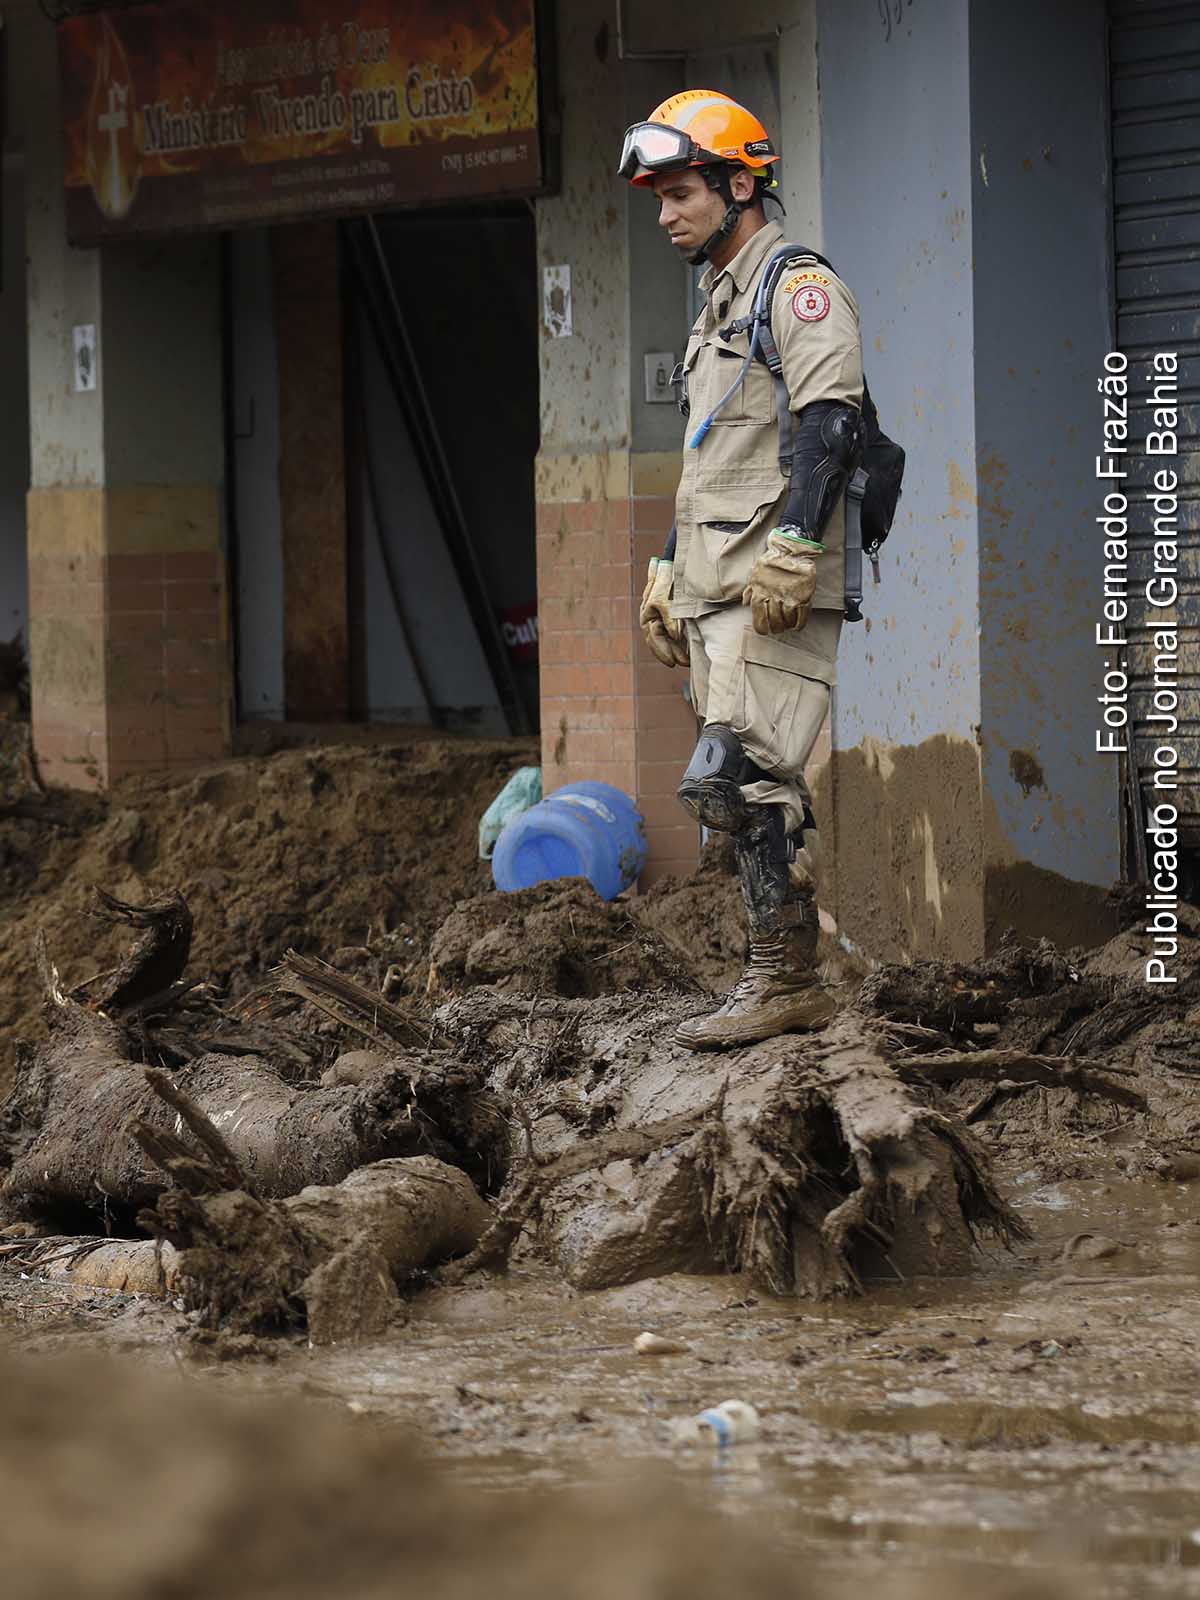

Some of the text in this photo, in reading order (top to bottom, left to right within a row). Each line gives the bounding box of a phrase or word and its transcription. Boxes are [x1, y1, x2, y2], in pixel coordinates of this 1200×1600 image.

[342, 20, 391, 70] Deus
[251, 71, 345, 137] Vivendo
[351, 83, 400, 144] para
[406, 65, 474, 121] Cristo
[502, 616, 538, 646] Cul
